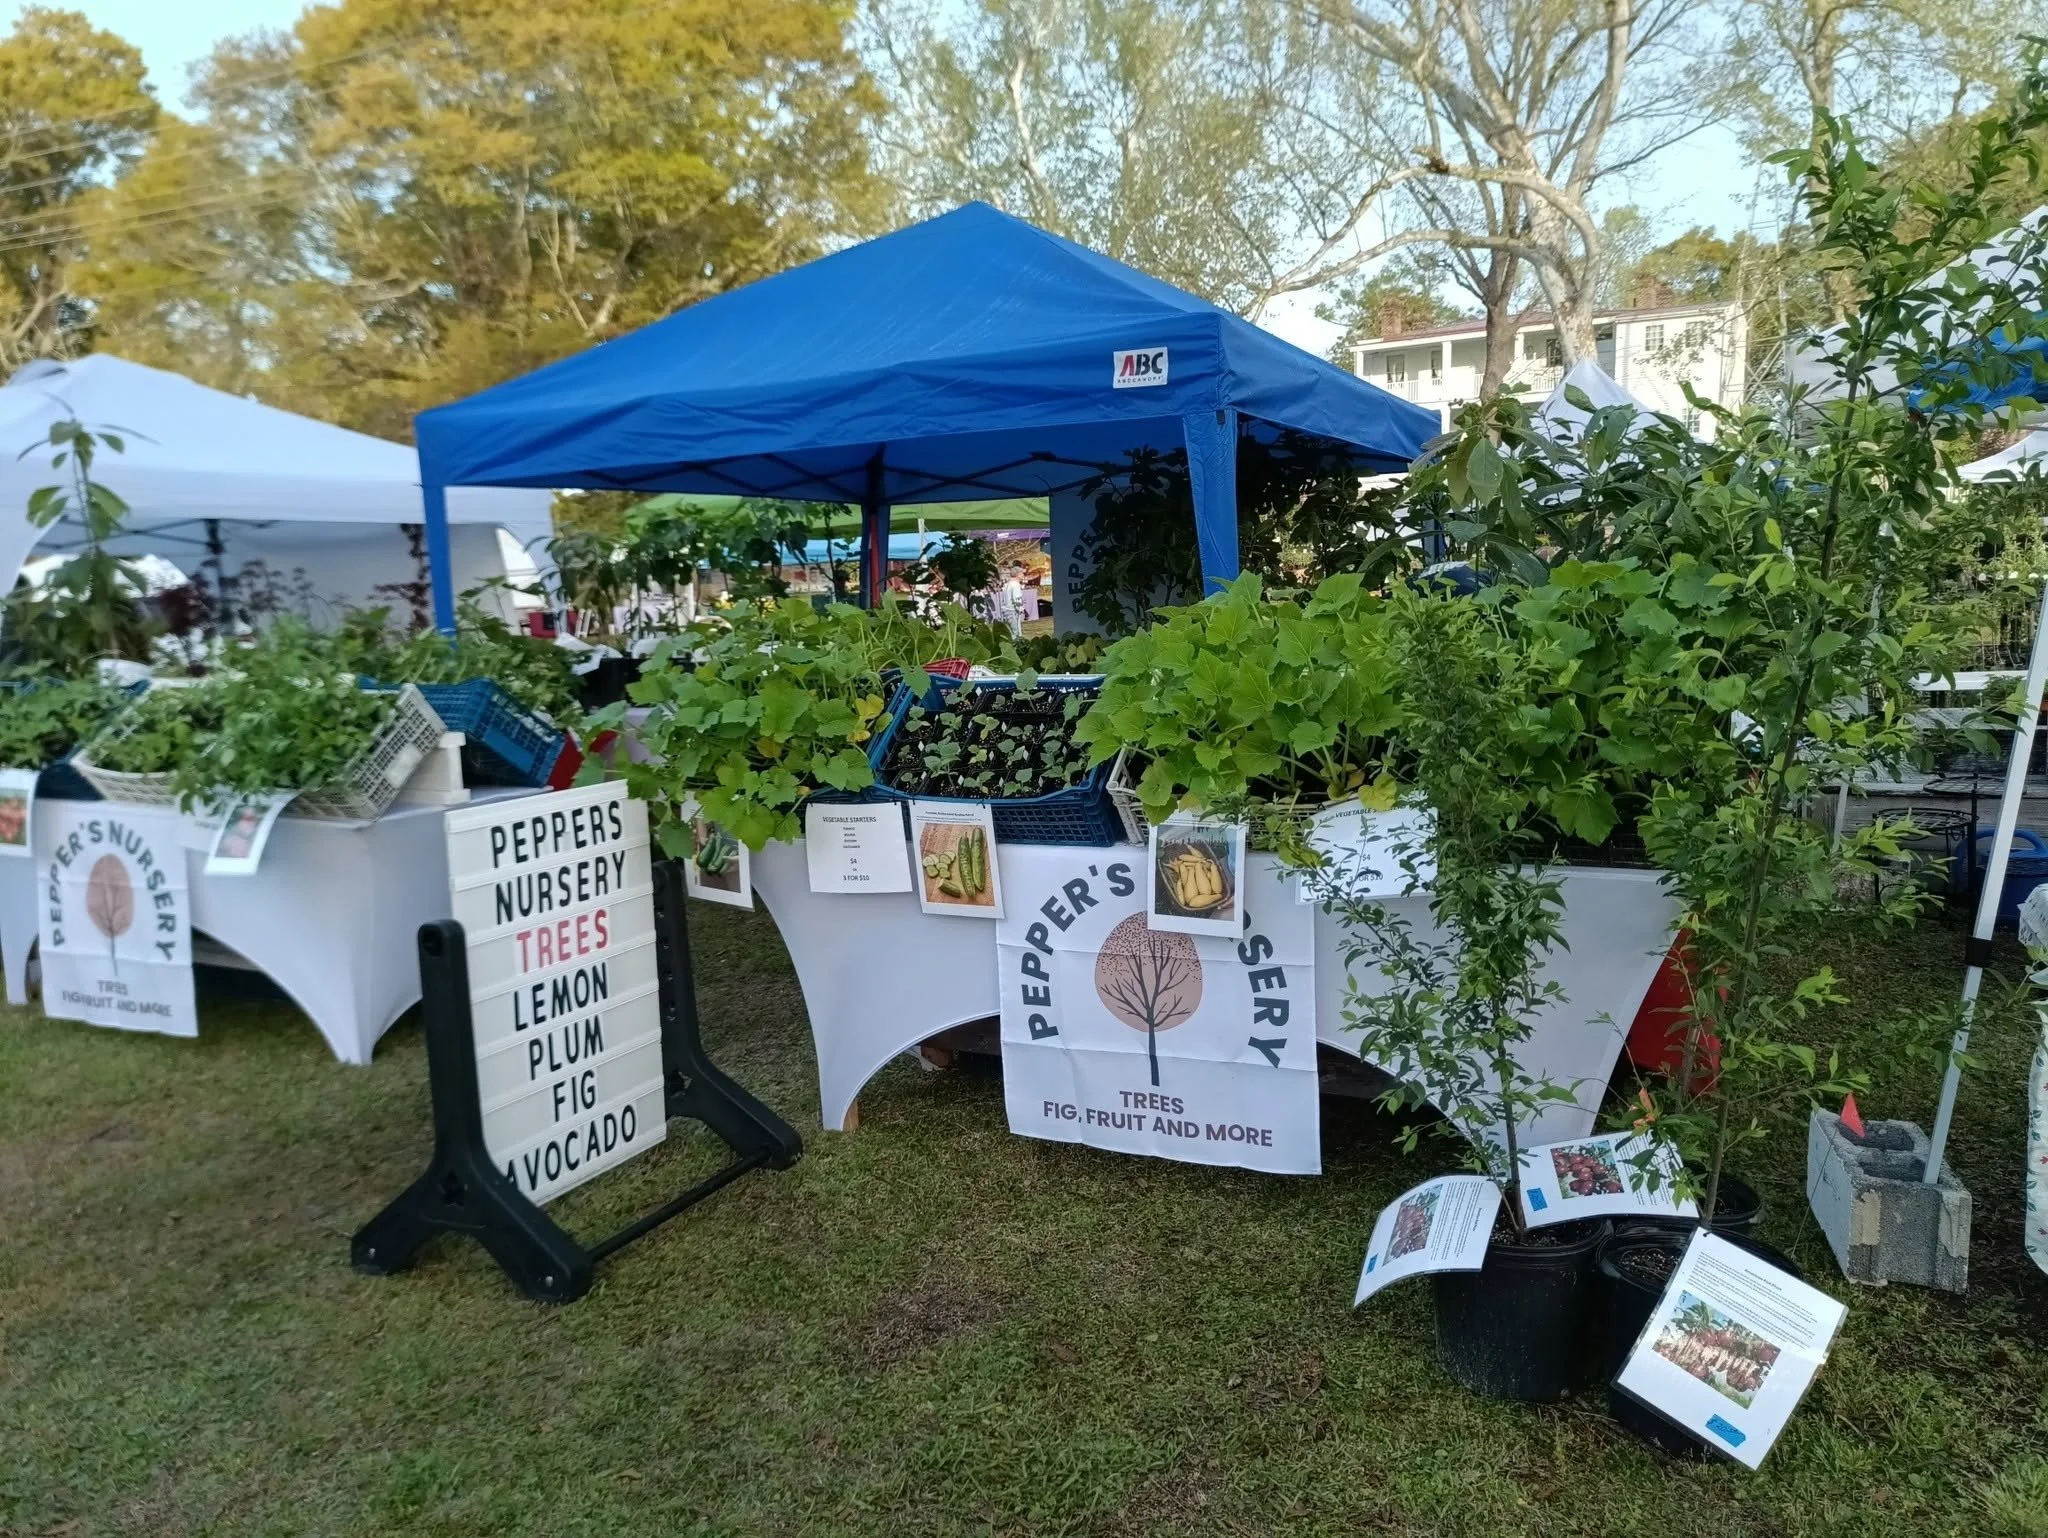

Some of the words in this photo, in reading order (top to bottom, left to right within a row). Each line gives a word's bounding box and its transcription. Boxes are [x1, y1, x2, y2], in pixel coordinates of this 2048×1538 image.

[1119, 351, 1164, 377] ABC
[491, 800, 623, 868] PEPPERS
[822, 815, 850, 824] VEGETABLE
[850, 815, 877, 824] STARTERS
[1335, 807, 1373, 818] VEGETABLE
[49, 820, 104, 947] PEPPER'S
[109, 820, 177, 961] NURSERY
[496, 850, 626, 925] NURSERY
[860, 874, 870, 882] $10
[516, 908, 609, 974] TREES
[1021, 862, 1135, 1041] PEPPER'S
[1229, 909, 1290, 1069] SERY
[514, 962, 608, 1032] LEMON
[529, 1014, 604, 1081] PLUM
[553, 1069, 596, 1122] FIG
[1043, 1100, 1083, 1124] FIG,
[1086, 1107, 1147, 1132] FRUIT
[1152, 1116, 1200, 1139] AND
[1205, 1122, 1273, 1148] MORE
[1119, 1090, 1184, 1115] TREES
[505, 1104, 637, 1192] AVOCADO
